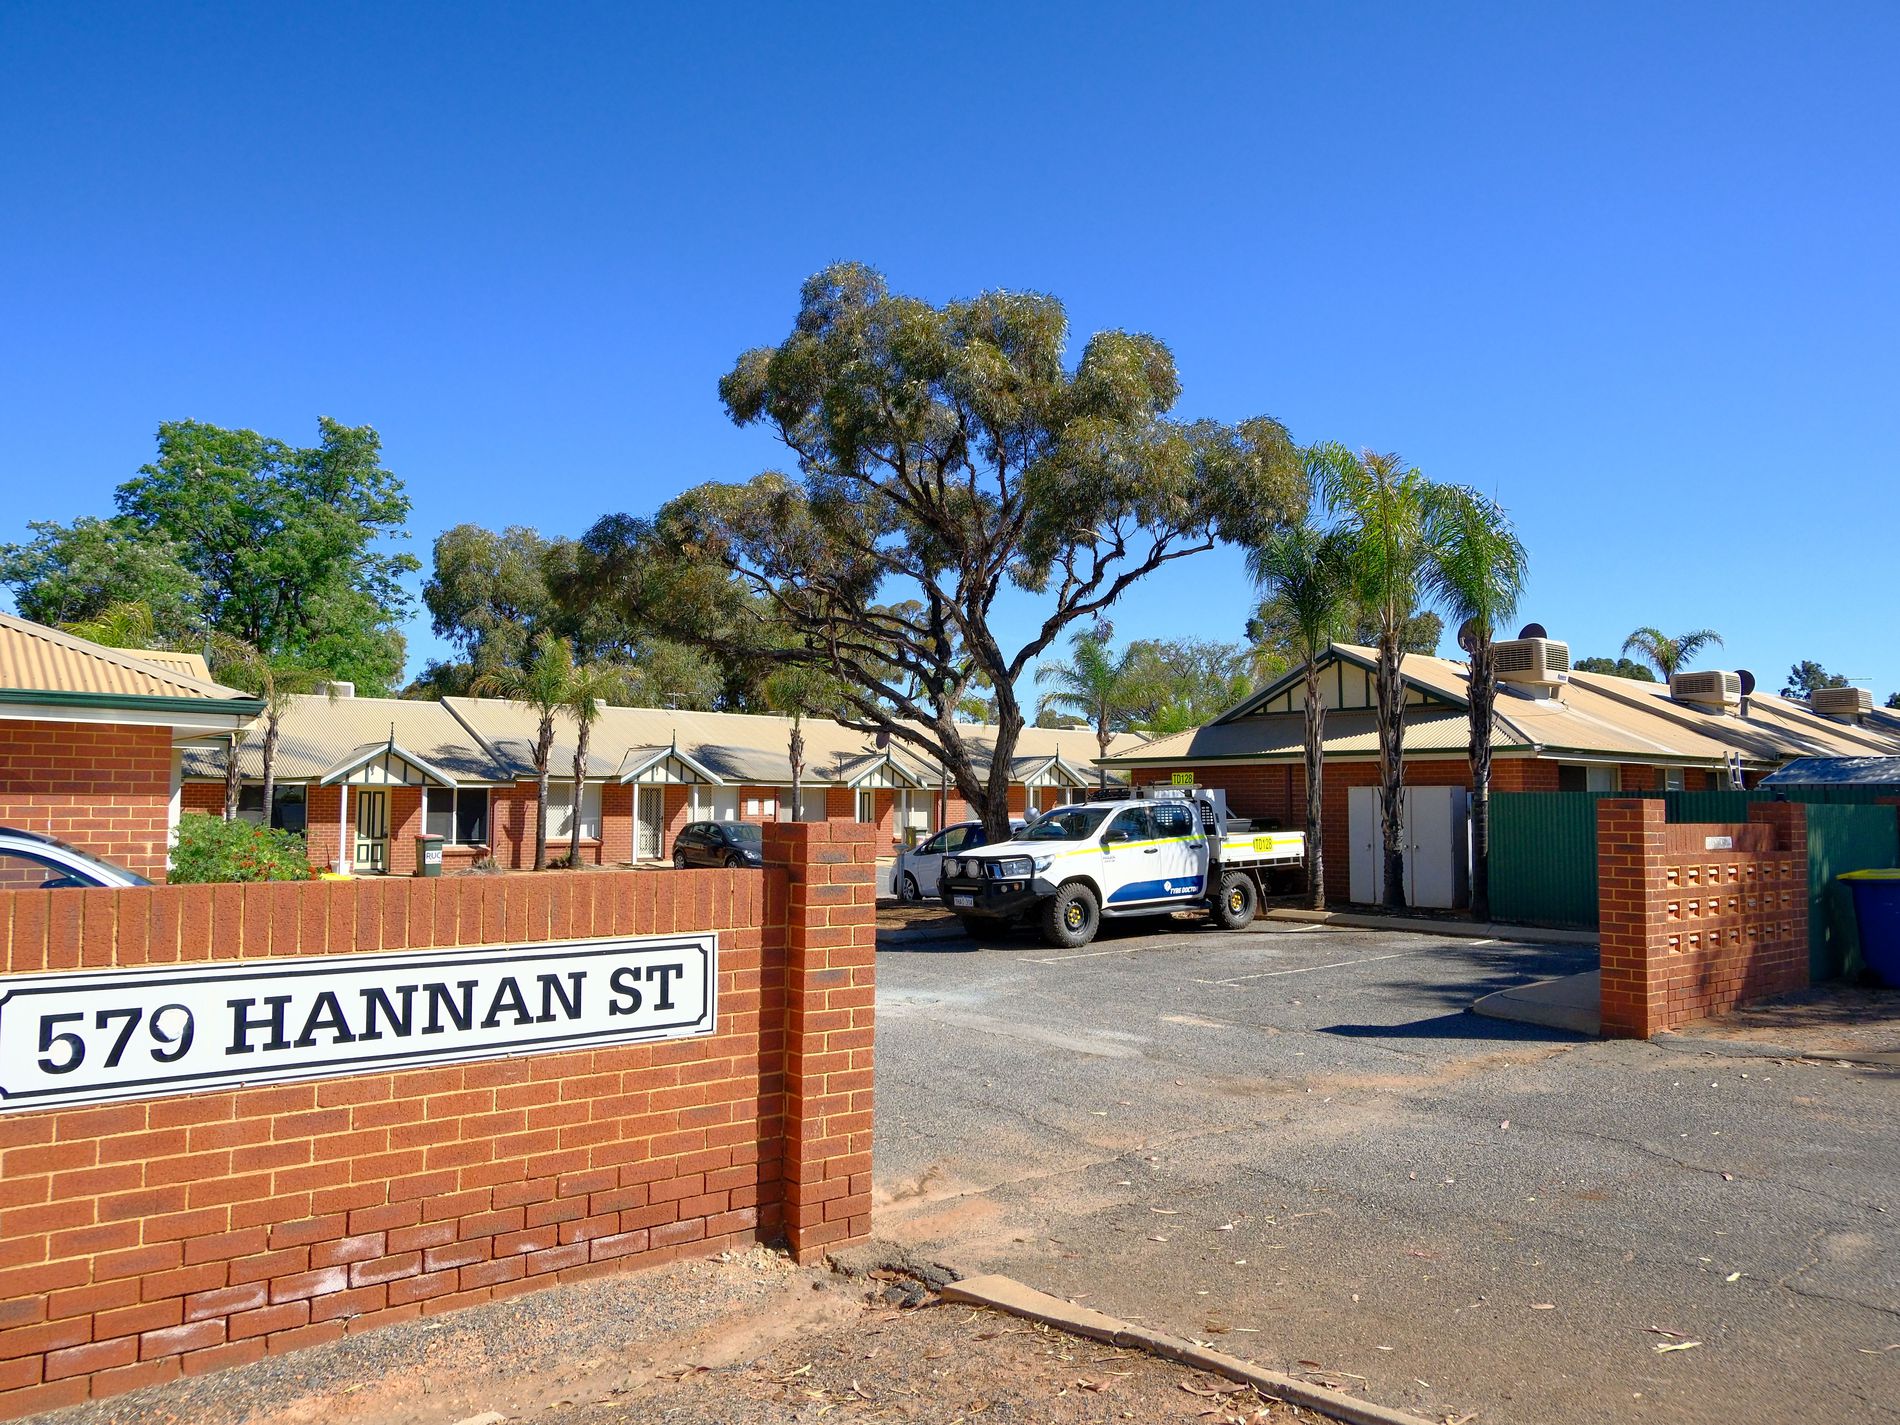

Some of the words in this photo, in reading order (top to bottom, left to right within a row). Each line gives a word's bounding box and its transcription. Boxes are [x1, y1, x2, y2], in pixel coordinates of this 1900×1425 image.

[1173, 774, 1193, 784] TD128
[1255, 838, 1272, 850] TD128
[37, 1003, 195, 1075] 579
[225, 971, 587, 1056] HANNAN
[609, 963, 683, 1016] ST
